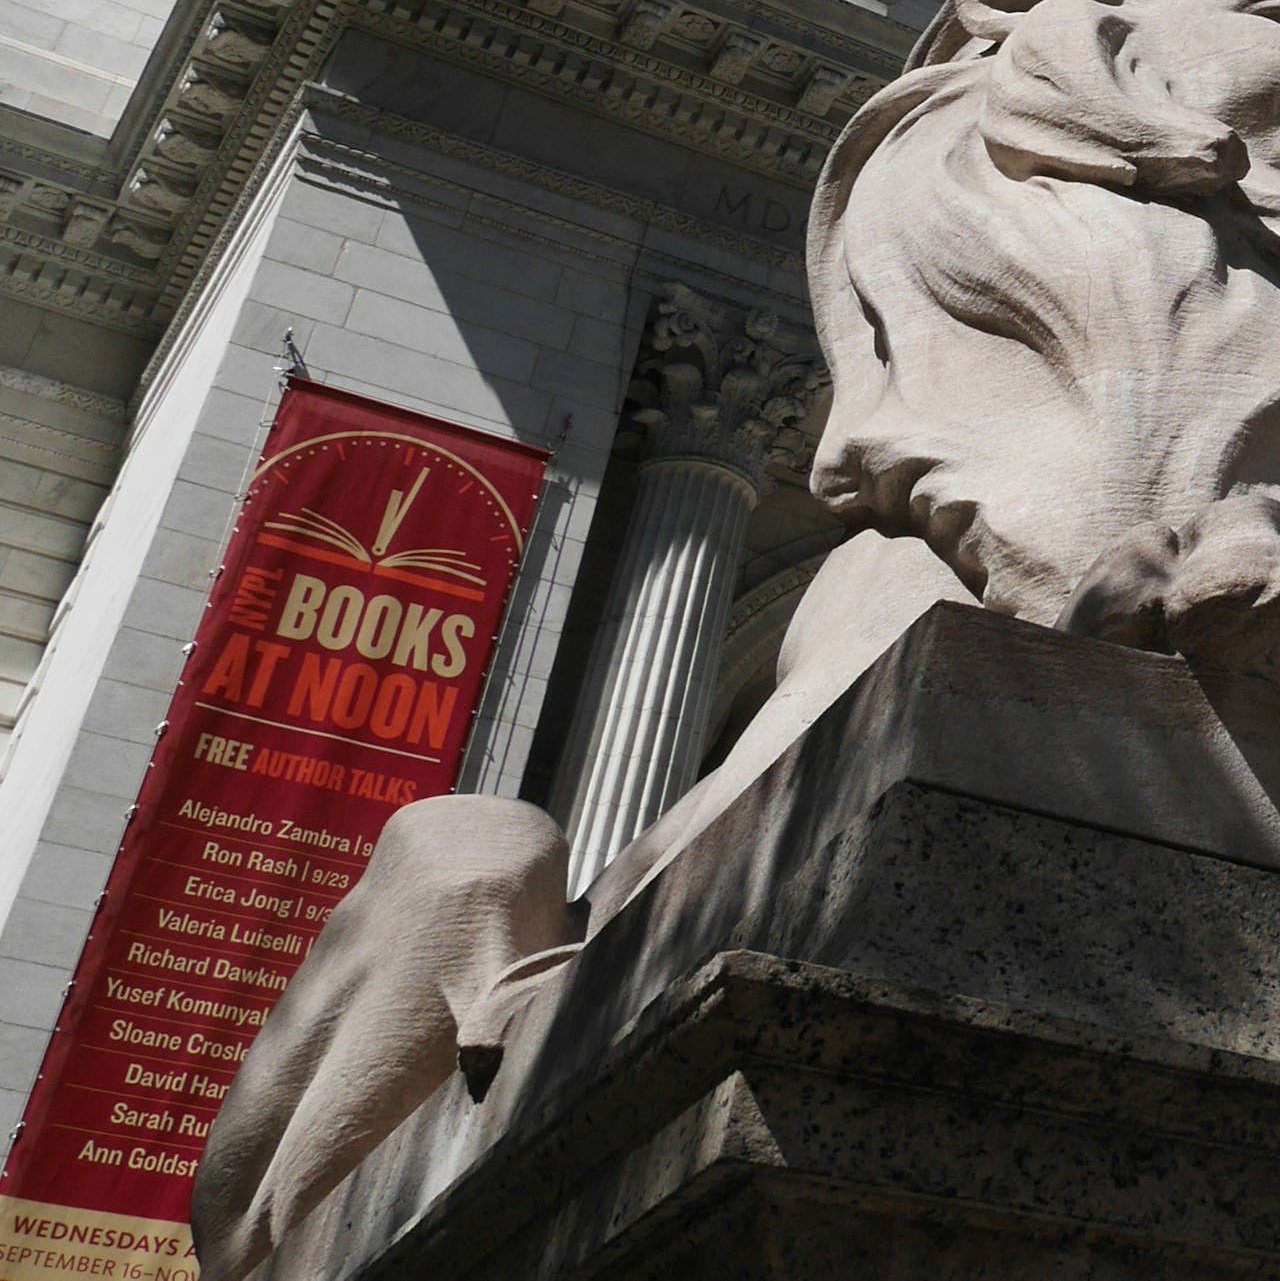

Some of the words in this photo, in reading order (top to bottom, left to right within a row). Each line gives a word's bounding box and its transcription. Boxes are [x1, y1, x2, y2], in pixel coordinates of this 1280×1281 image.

[228, 566, 286, 631] NYPL
[276, 572, 475, 678] BOOKS
[201, 632, 291, 708] AT
[286, 651, 458, 750] NOON
[194, 732, 254, 770] FREE
[252, 748, 346, 792] AUTHOR
[348, 769, 417, 806] TALKS
[178, 799, 273, 836] Alejandro
[276, 819, 351, 853] Zambra
[202, 841, 243, 867] Ron
[247, 850, 298, 878] Rash
[311, 868, 350, 889] 9/23
[184, 876, 237, 904] Erica
[240, 887, 294, 918] Jong
[158, 908, 227, 941] Valeria
[230, 923, 304, 956] Luiselli
[127, 941, 211, 976] Richard
[105, 977, 166, 1007] Yusef
[109, 1018, 182, 1051] Sloane
[124, 1063, 188, 1092] David
[110, 1101, 174, 1132] Sarah
[77, 1139, 124, 1166] Ann
[13, 1215, 181, 1257] WEDNESDAYS
[0, 1243, 117, 1278] SEPTEMBER
